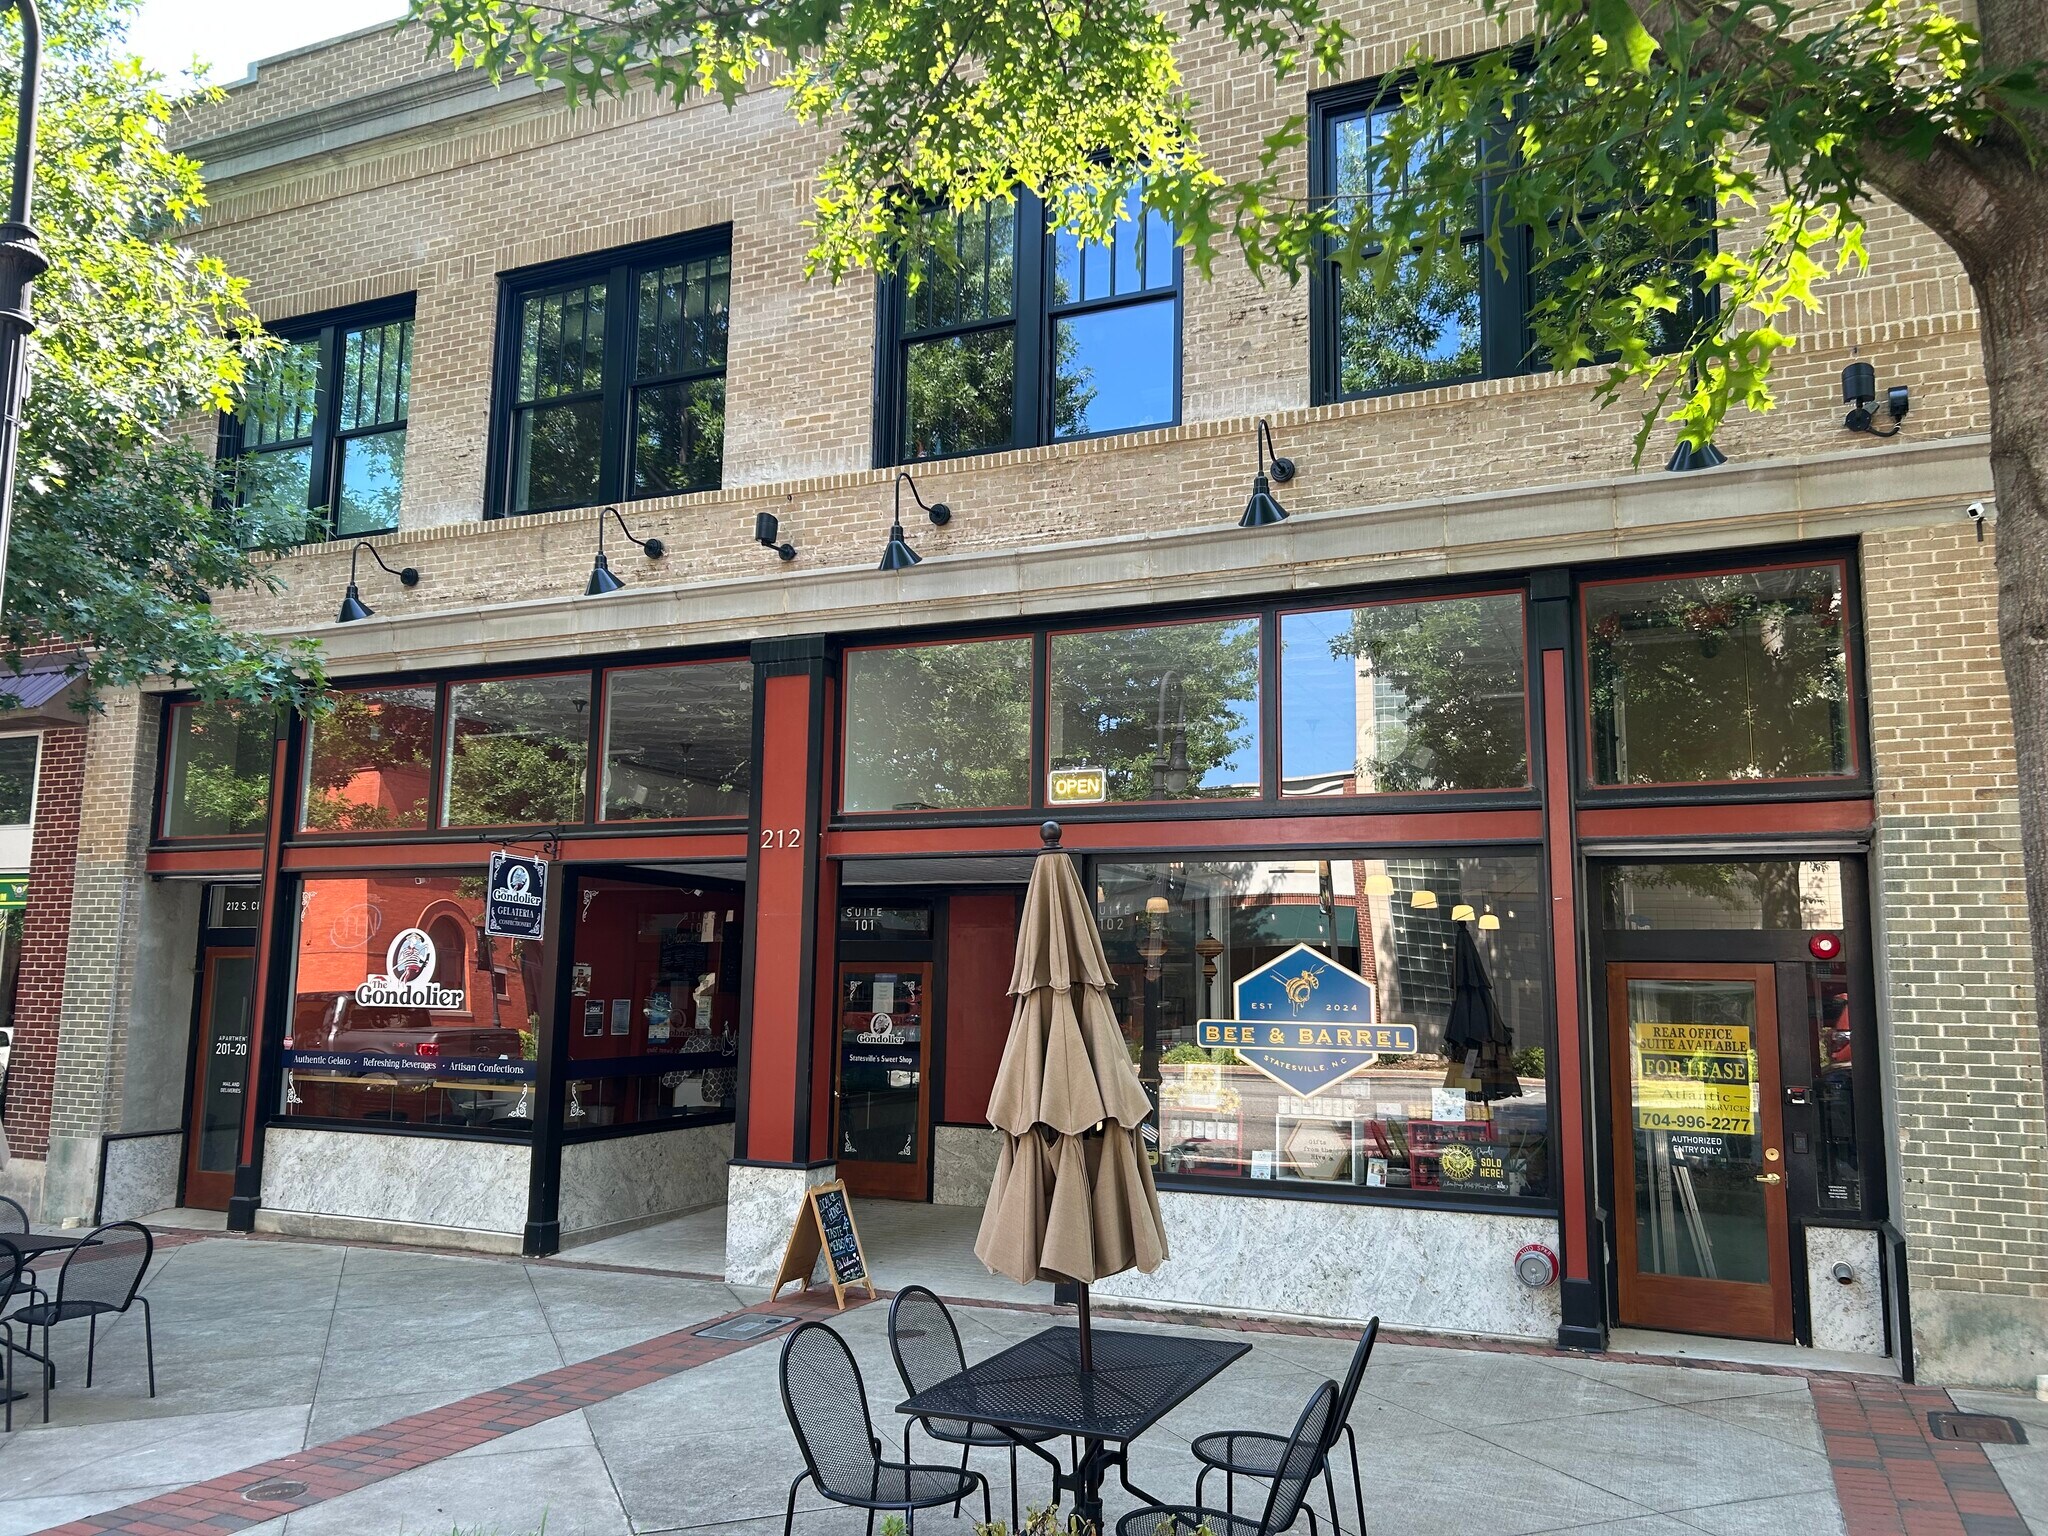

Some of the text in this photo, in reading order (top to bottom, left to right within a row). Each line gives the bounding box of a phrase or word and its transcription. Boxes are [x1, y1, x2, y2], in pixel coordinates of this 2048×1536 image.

[1056, 778, 1100, 794] OPEN
[761, 829, 800, 848] 212
[494, 890, 541, 905] Gondolier
[226, 902, 240, 911] 212
[498, 906, 534, 919] GELATERIA
[847, 908, 882, 917] SUITE
[1099, 904, 1130, 915] UITE
[333, 913, 378, 938] OPEN
[855, 920, 874, 931] 101
[1100, 918, 1123, 930] 102
[371, 980, 388, 989] The
[357, 985, 462, 1006] Gondolier
[1326, 1004, 1358, 1012] 2024
[858, 1035, 904, 1043] Gondolier
[1205, 1026, 1410, 1048] BEE & BARREL
[1653, 1027, 1733, 1040] REAR OFFICE
[1640, 1038, 1748, 1052] SUITE AVAILABLE
[294, 1054, 351, 1066] Authentic Gelato
[363, 1057, 437, 1071] Refreshing Beverages
[881, 1055, 898, 1063] Sweet
[899, 1055, 913, 1064] Shop
[449, 1062, 524, 1074] Artisan Confections
[1645, 1059, 1746, 1080] FOR LEASE
[1661, 1089, 1731, 1103] Atlantic
[1706, 1104, 1750, 1113] SERVICES
[1642, 1113, 1750, 1132] 704-996-2277
[1671, 1136, 1722, 1145] AUTHORIZED
[1673, 1145, 1722, 1155] ENTRY ONLY
[1481, 1157, 1502, 1168] SOLD
[1479, 1168, 1504, 1179] HERE!
[827, 1201, 844, 1221] HONEY
[826, 1225, 844, 1240] TASTE
[829, 1237, 846, 1253] MEADS
